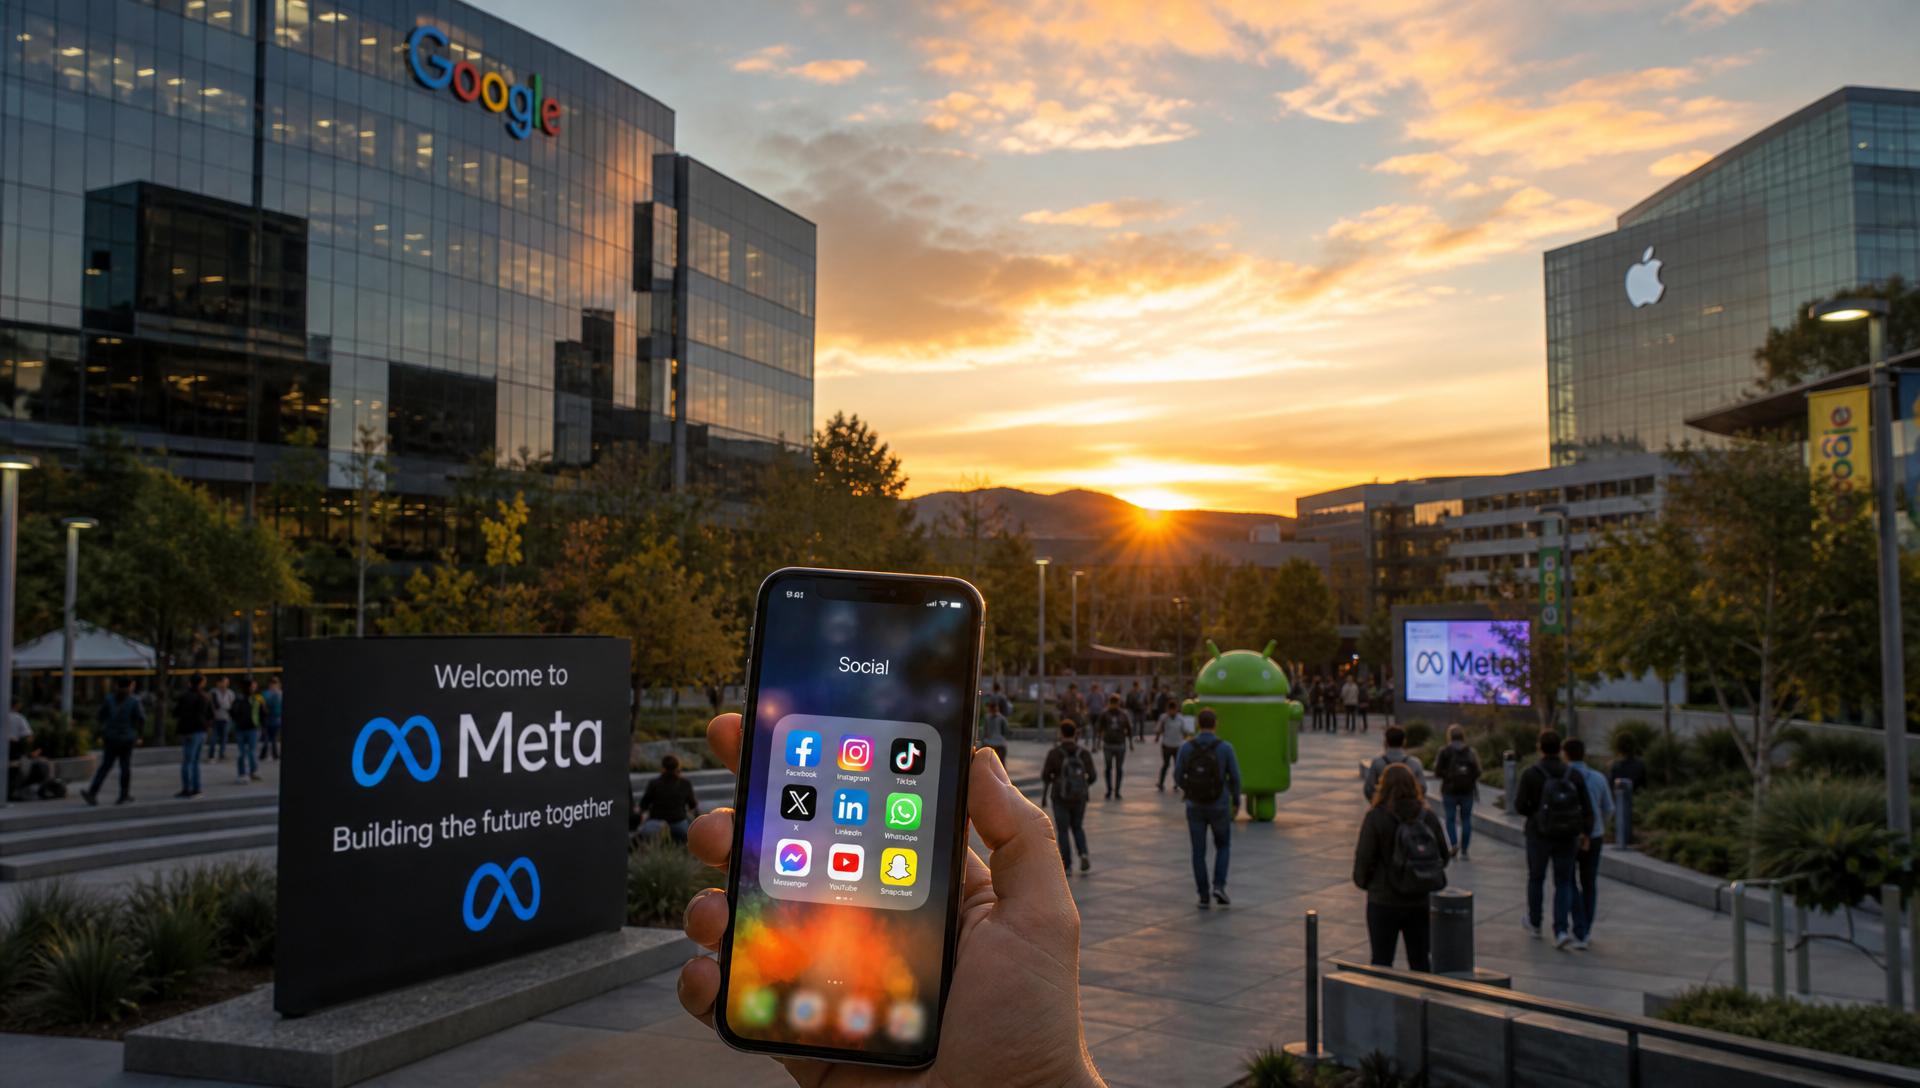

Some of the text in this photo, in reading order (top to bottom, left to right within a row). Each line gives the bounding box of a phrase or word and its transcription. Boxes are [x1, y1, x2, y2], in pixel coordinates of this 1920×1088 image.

[408, 25, 562, 138] Google
[434, 663, 568, 689] Welcome to
[838, 656, 890, 675] Social
[1451, 650, 1516, 676] Meta
[458, 710, 603, 778] Meta
[785, 769, 818, 778] Facebook
[836, 773, 870, 783] Instagram
[838, 793, 863, 820] in
[333, 797, 613, 852] Building the future together
[829, 883, 858, 892] YouTube
